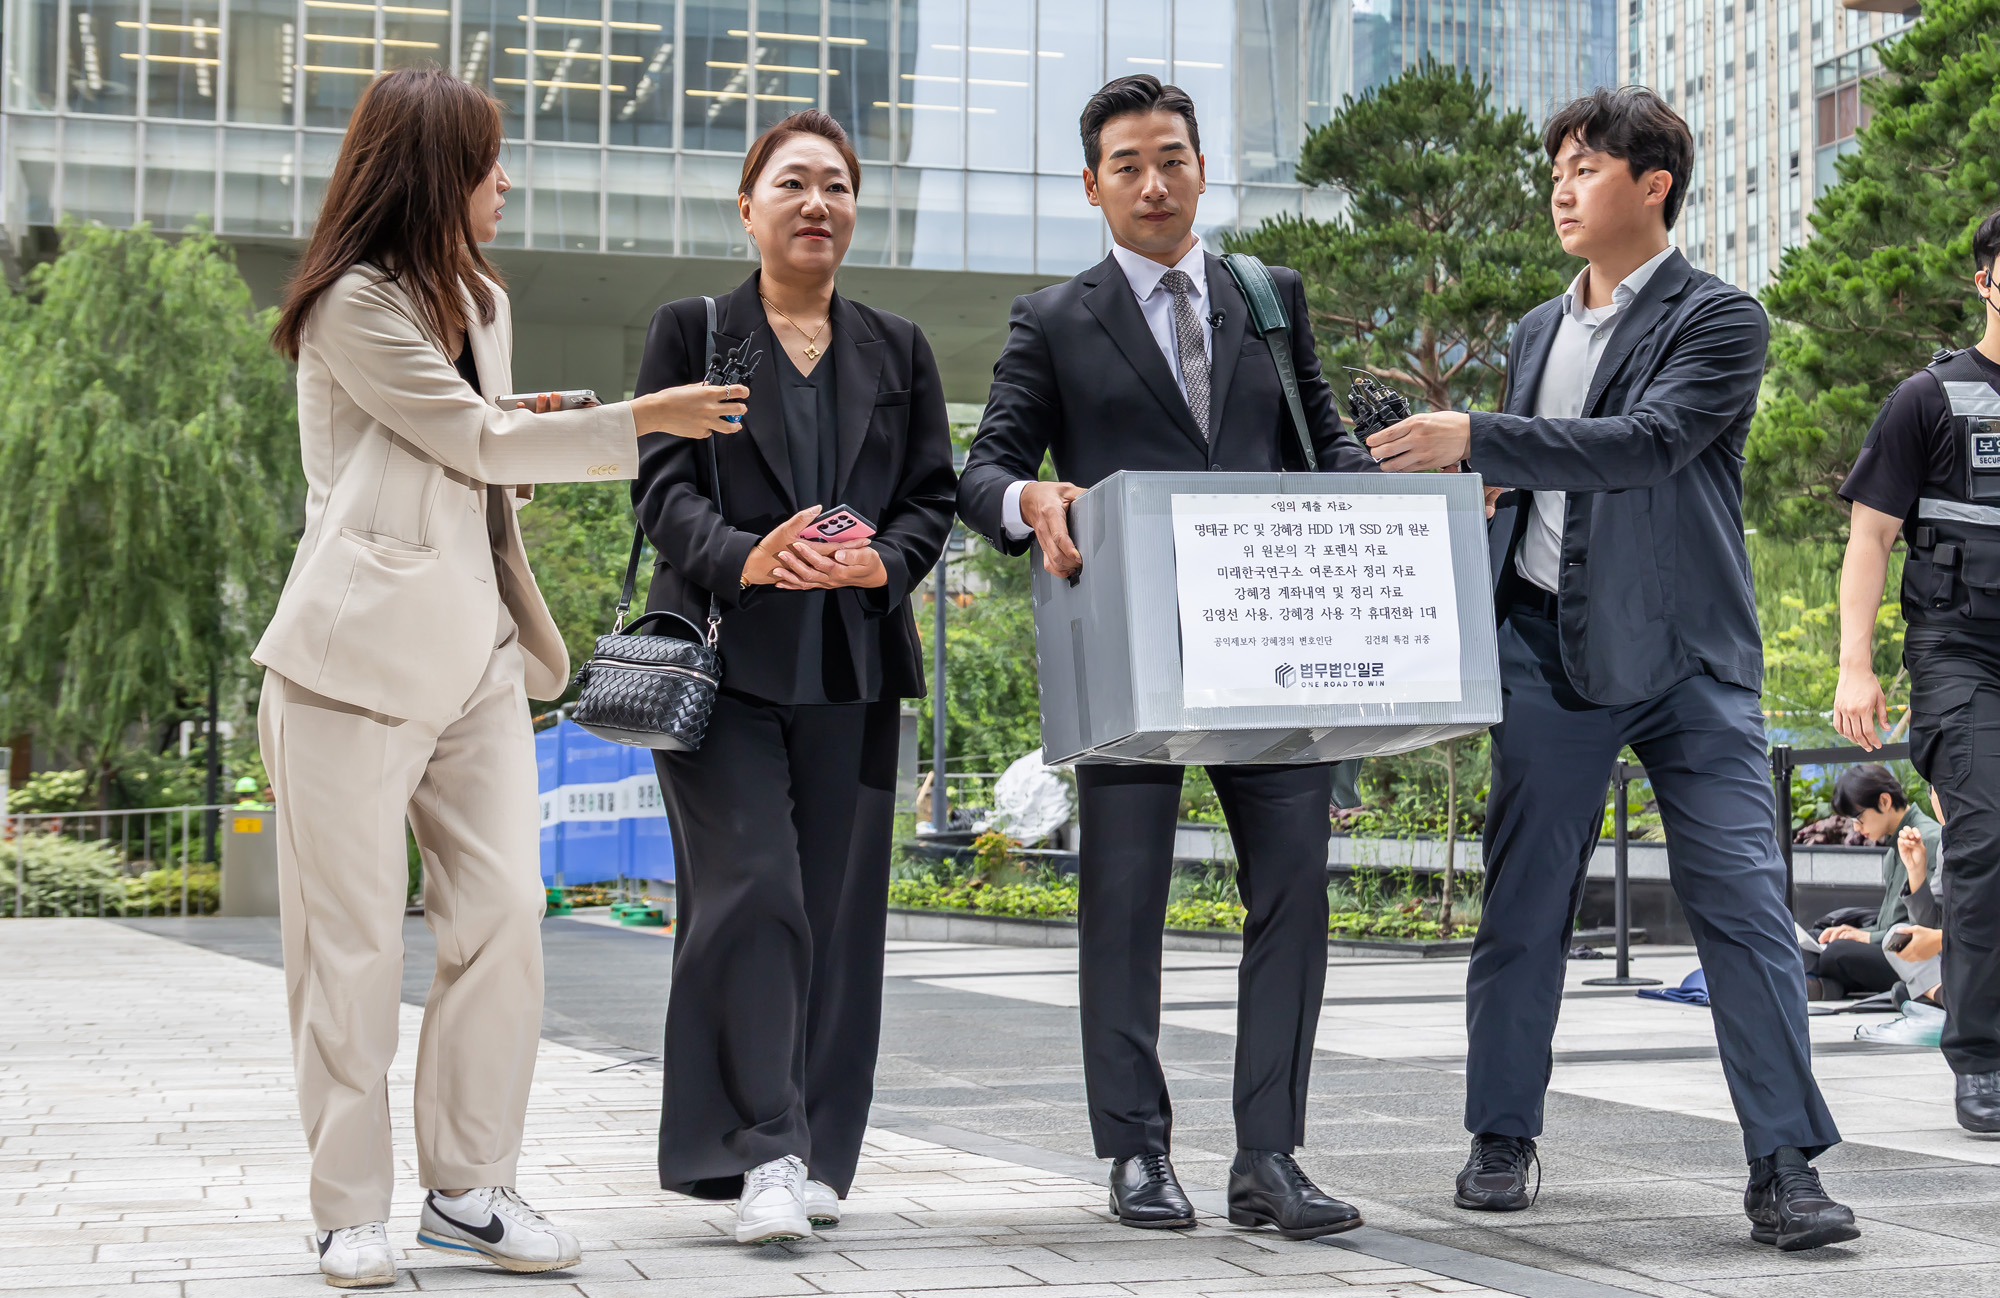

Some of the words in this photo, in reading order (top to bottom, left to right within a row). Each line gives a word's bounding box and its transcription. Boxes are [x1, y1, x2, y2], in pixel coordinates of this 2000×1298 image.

[1979, 440, 2000, 452] 보
[1271, 501, 1296, 513] <임의
[1301, 501, 1322, 513] 제출
[1327, 501, 1353, 513] 자료>
[1194, 523, 1230, 537] 명태균
[1233, 523, 1249, 536] PC
[1254, 523, 1265, 537] 및
[1270, 523, 1303, 537] 강혜경
[1308, 523, 1334, 535] HDD
[1338, 523, 1356, 537] 1개
[1359, 523, 1382, 535] SSD
[1386, 523, 1404, 537] 2개
[1408, 523, 1430, 537] 원본
[1243, 545, 1255, 558] 위
[1261, 544, 1297, 558] 원본의
[1304, 544, 1317, 558] 각
[1322, 544, 1358, 558] 포렌식
[1364, 544, 1389, 557] 자료
[1217, 565, 1304, 580] 미래한국연구소
[1309, 565, 1358, 579] 여론조사
[1363, 565, 1386, 578] 정리
[1392, 565, 1417, 578] 자료
[1234, 587, 1271, 600] 강혜경
[1277, 586, 1326, 600] 계좌내역
[1332, 586, 1344, 600] 및
[1350, 586, 1374, 600] 정리
[1379, 586, 1404, 599] 자료
[1202, 608, 1239, 623] 김영선
[1244, 608, 1273, 622] 사용,
[1278, 607, 1314, 622] 강혜경
[1320, 607, 1345, 621] 사용
[1349, 607, 1363, 621] 각
[1367, 607, 1414, 620] 휴대전화
[1419, 606, 1437, 620] 1대
[1213, 636, 1257, 647] 공익제보자
[1261, 636, 1295, 647] 강혜경의
[1299, 635, 1333, 646] 변호인단
[1364, 635, 1389, 646] 김건희
[1393, 635, 1410, 645] 특검
[1414, 635, 1431, 645] 귀중
[1301, 681, 1320, 689] ONE
[1367, 680, 1385, 688] WIN
